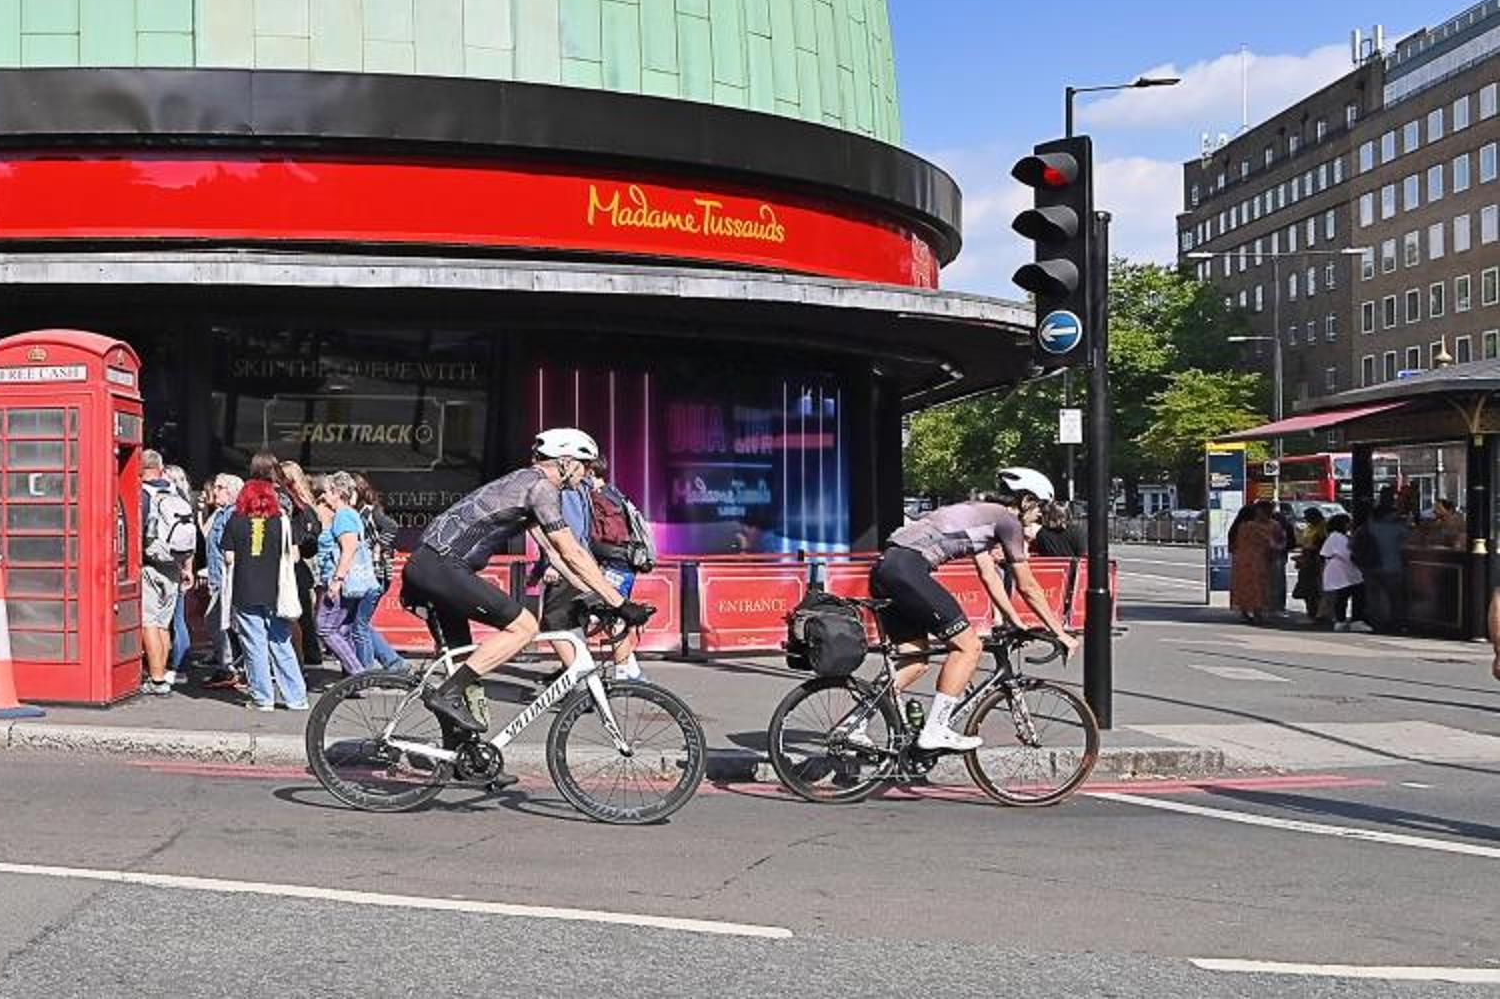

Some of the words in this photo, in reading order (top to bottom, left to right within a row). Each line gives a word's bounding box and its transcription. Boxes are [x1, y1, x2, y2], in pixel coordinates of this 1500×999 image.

[588, 184, 700, 232] Madame
[694, 198, 786, 243] Tussauds
[302, 423, 348, 443] FAST
[349, 423, 413, 443] TRACK
[387, 490, 437, 506] STAFF
[718, 597, 788, 613] ENTRANCE
